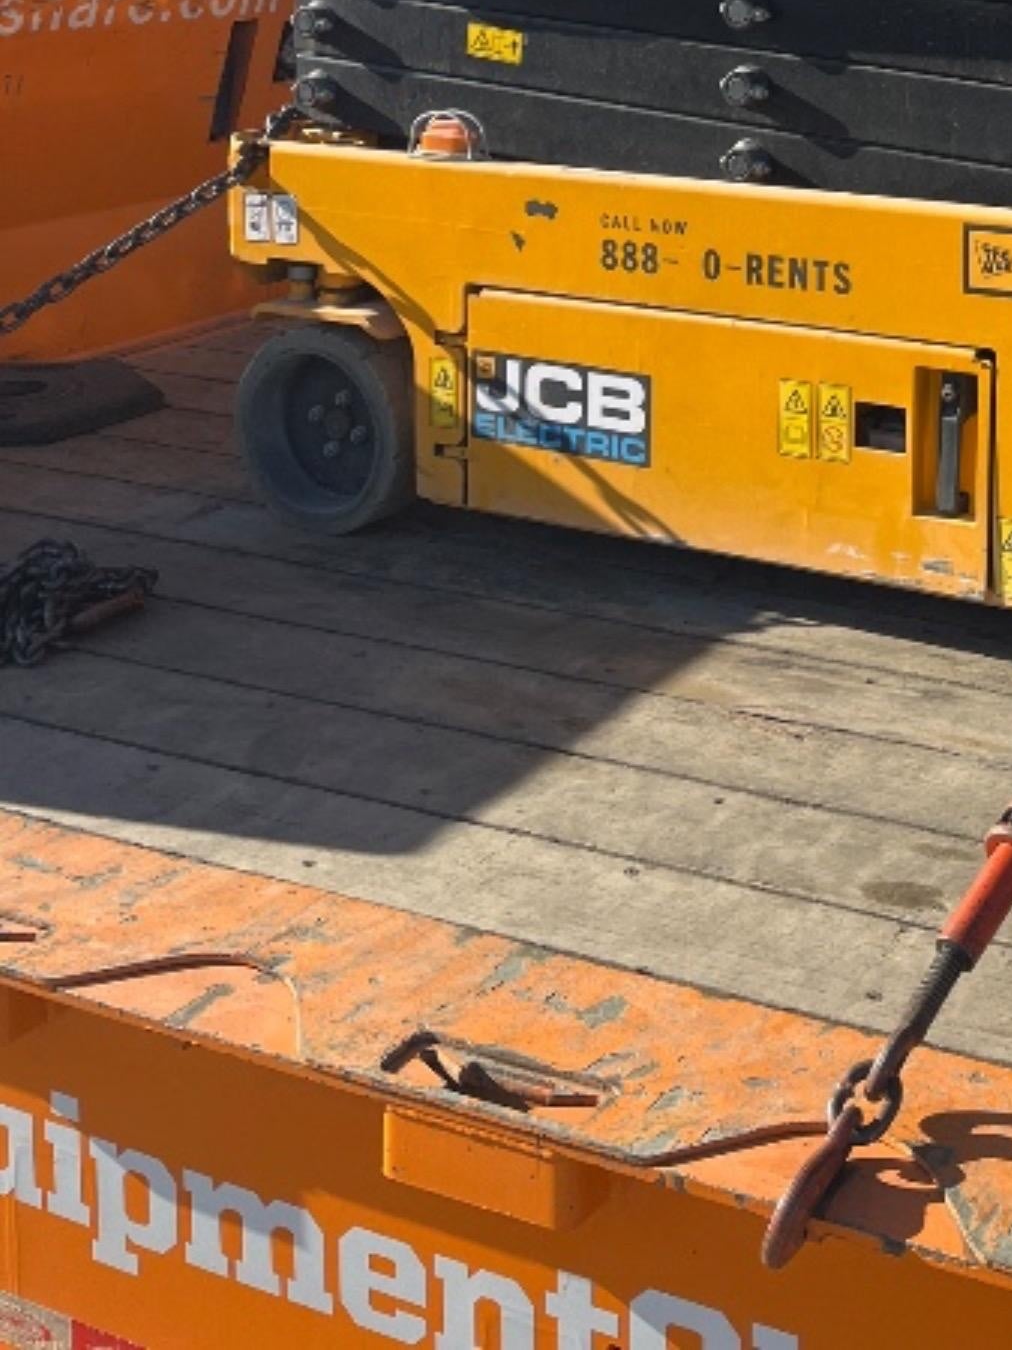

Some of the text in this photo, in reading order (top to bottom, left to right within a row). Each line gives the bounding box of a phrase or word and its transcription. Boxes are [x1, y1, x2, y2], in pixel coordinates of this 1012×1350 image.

[475, 359, 646, 434] JCB
[474, 412, 646, 464] ELECTRIC
[0, 1089, 799, 1350] ipment
